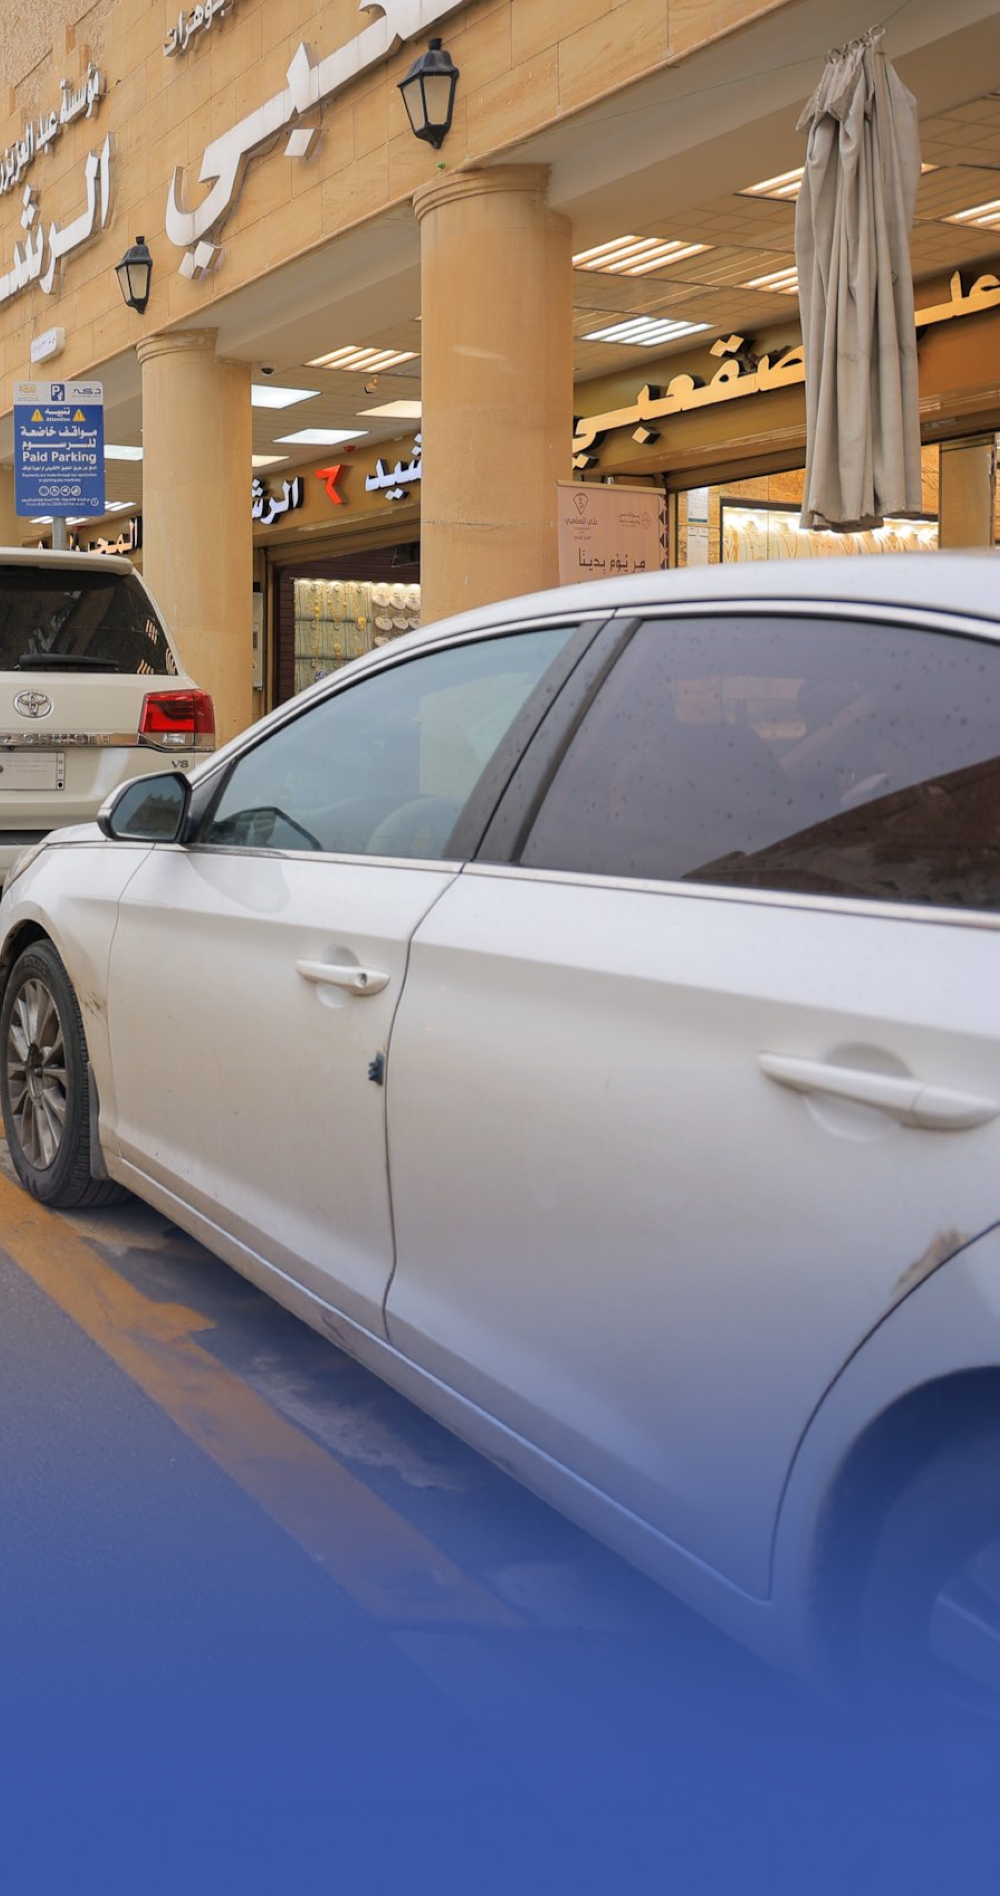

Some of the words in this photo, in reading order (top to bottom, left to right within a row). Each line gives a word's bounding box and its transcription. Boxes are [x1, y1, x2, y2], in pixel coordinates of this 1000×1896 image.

[44, 406, 71, 417] تنبيه
[20, 425, 57, 436] خاضعة
[58, 425, 98, 439] مواقف
[22, 438, 97, 451] للرسوم
[22, 451, 48, 462] Paid
[51, 451, 97, 464] Parking
